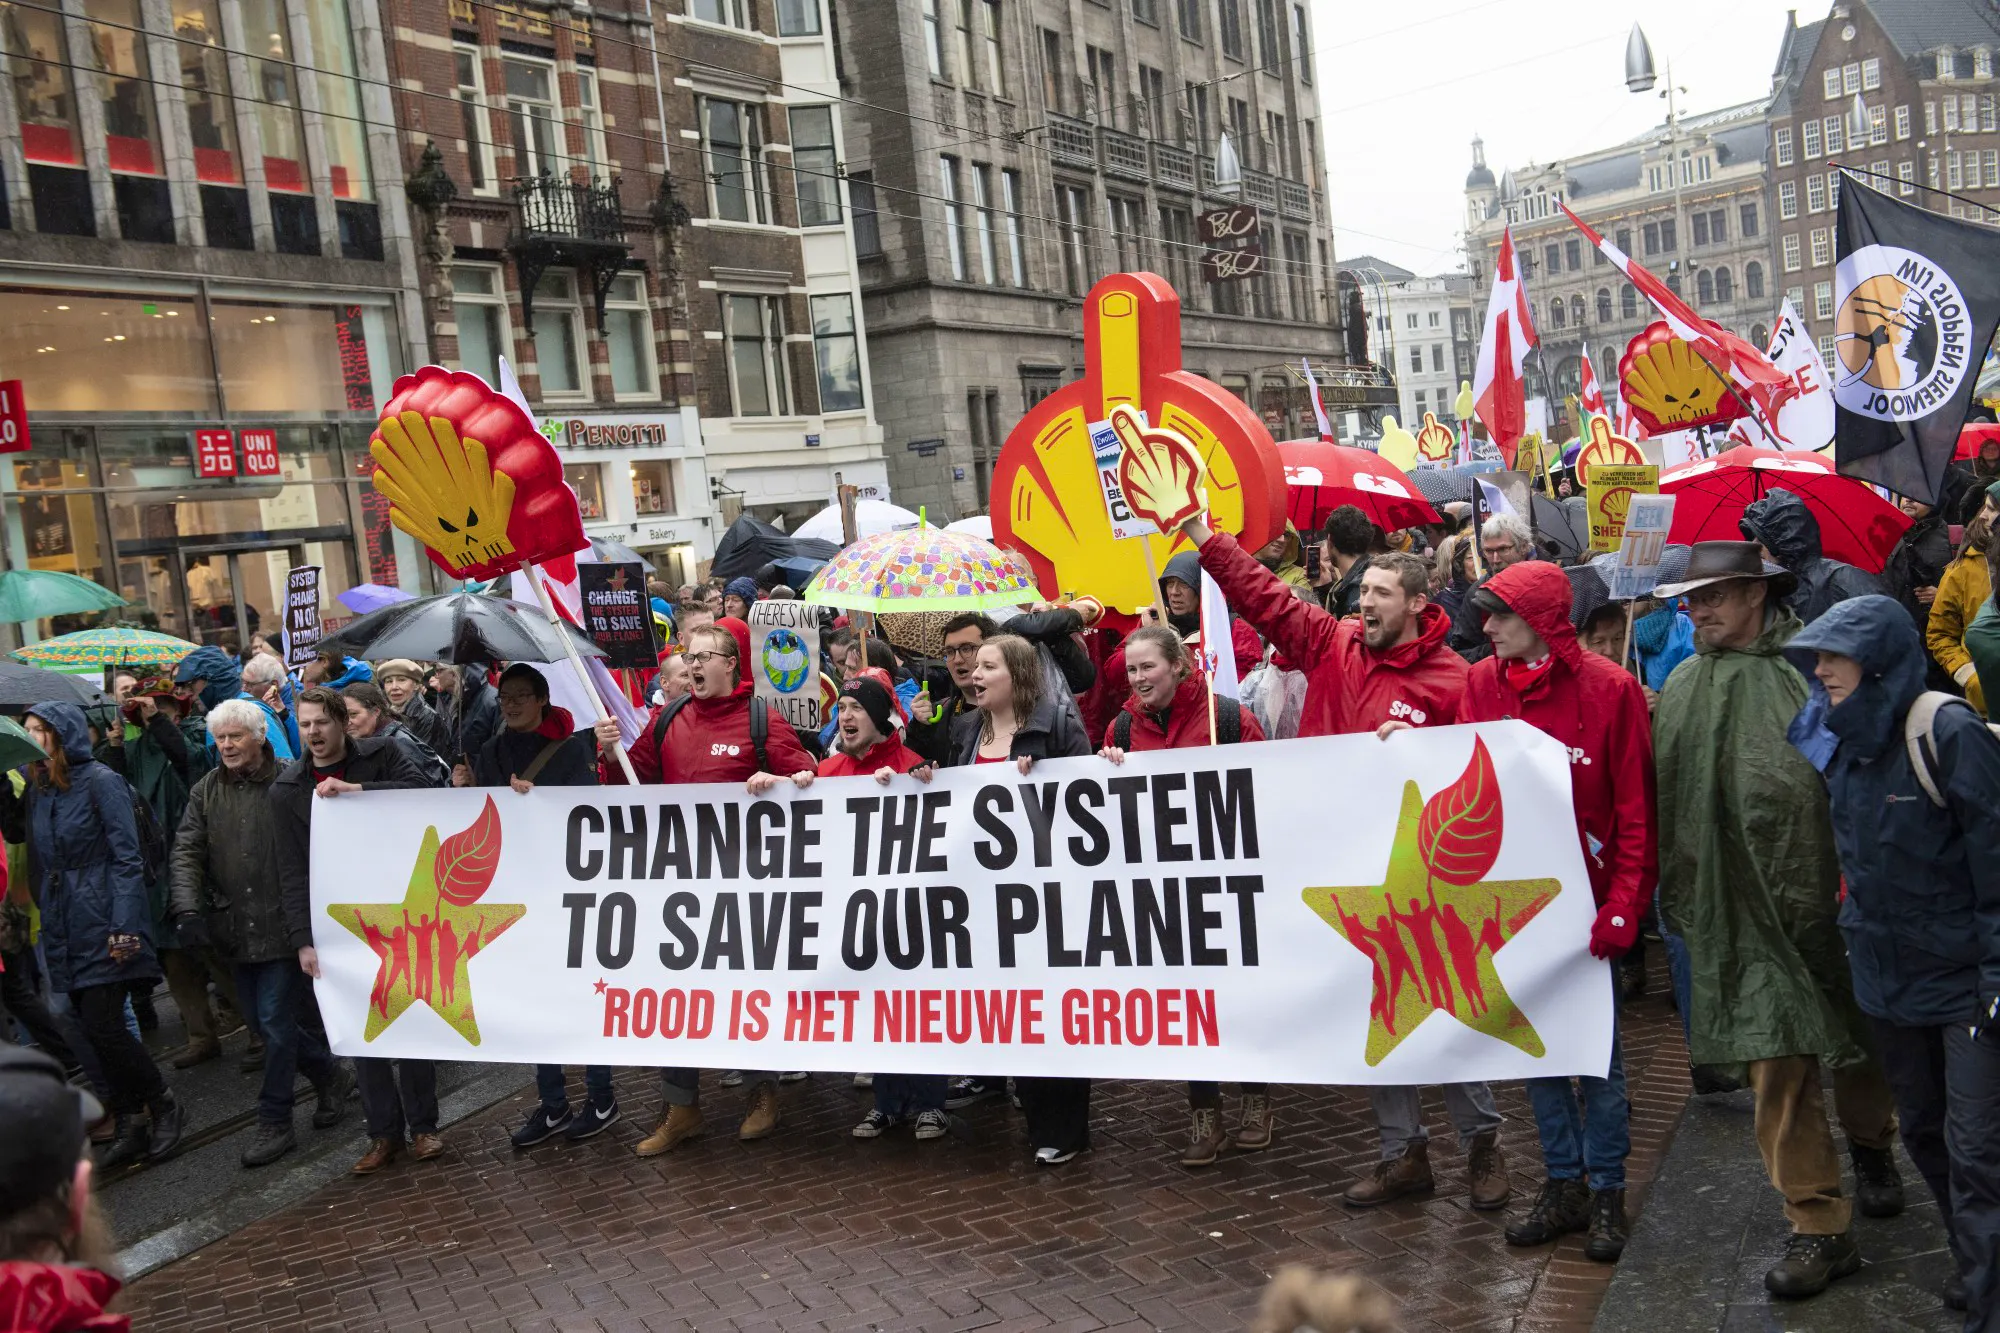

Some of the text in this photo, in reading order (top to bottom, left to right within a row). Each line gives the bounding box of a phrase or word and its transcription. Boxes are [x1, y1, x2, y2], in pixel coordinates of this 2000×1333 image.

[1207, 210, 1256, 238] P&C
[1211, 250, 1259, 278] P&C
[244, 434, 272, 451] UNI
[1095, 432, 1115, 447] Zwolle
[247, 453, 276, 473] QLO
[649, 528, 676, 541] Bakery
[1592, 525, 1624, 538] SHEL
[291, 570, 316, 589] SYSTEM
[290, 589, 316, 607] CHANGE
[588, 590, 638, 605] CHANGE
[294, 606, 315, 628] NOT
[590, 605, 639, 616] THE SYSTEM
[752, 602, 819, 630] THERE'S NO
[592, 616, 643, 631] TO SAVE
[293, 627, 319, 646] CLIMATE
[613, 631, 645, 640] PLANET
[566, 768, 1260, 881] CHANGE THE SYSTEM
[562, 875, 1264, 972] TO SAVE OUR PLANET
[603, 987, 1220, 1047] ROOD IS HET NIEUWE GROEN
